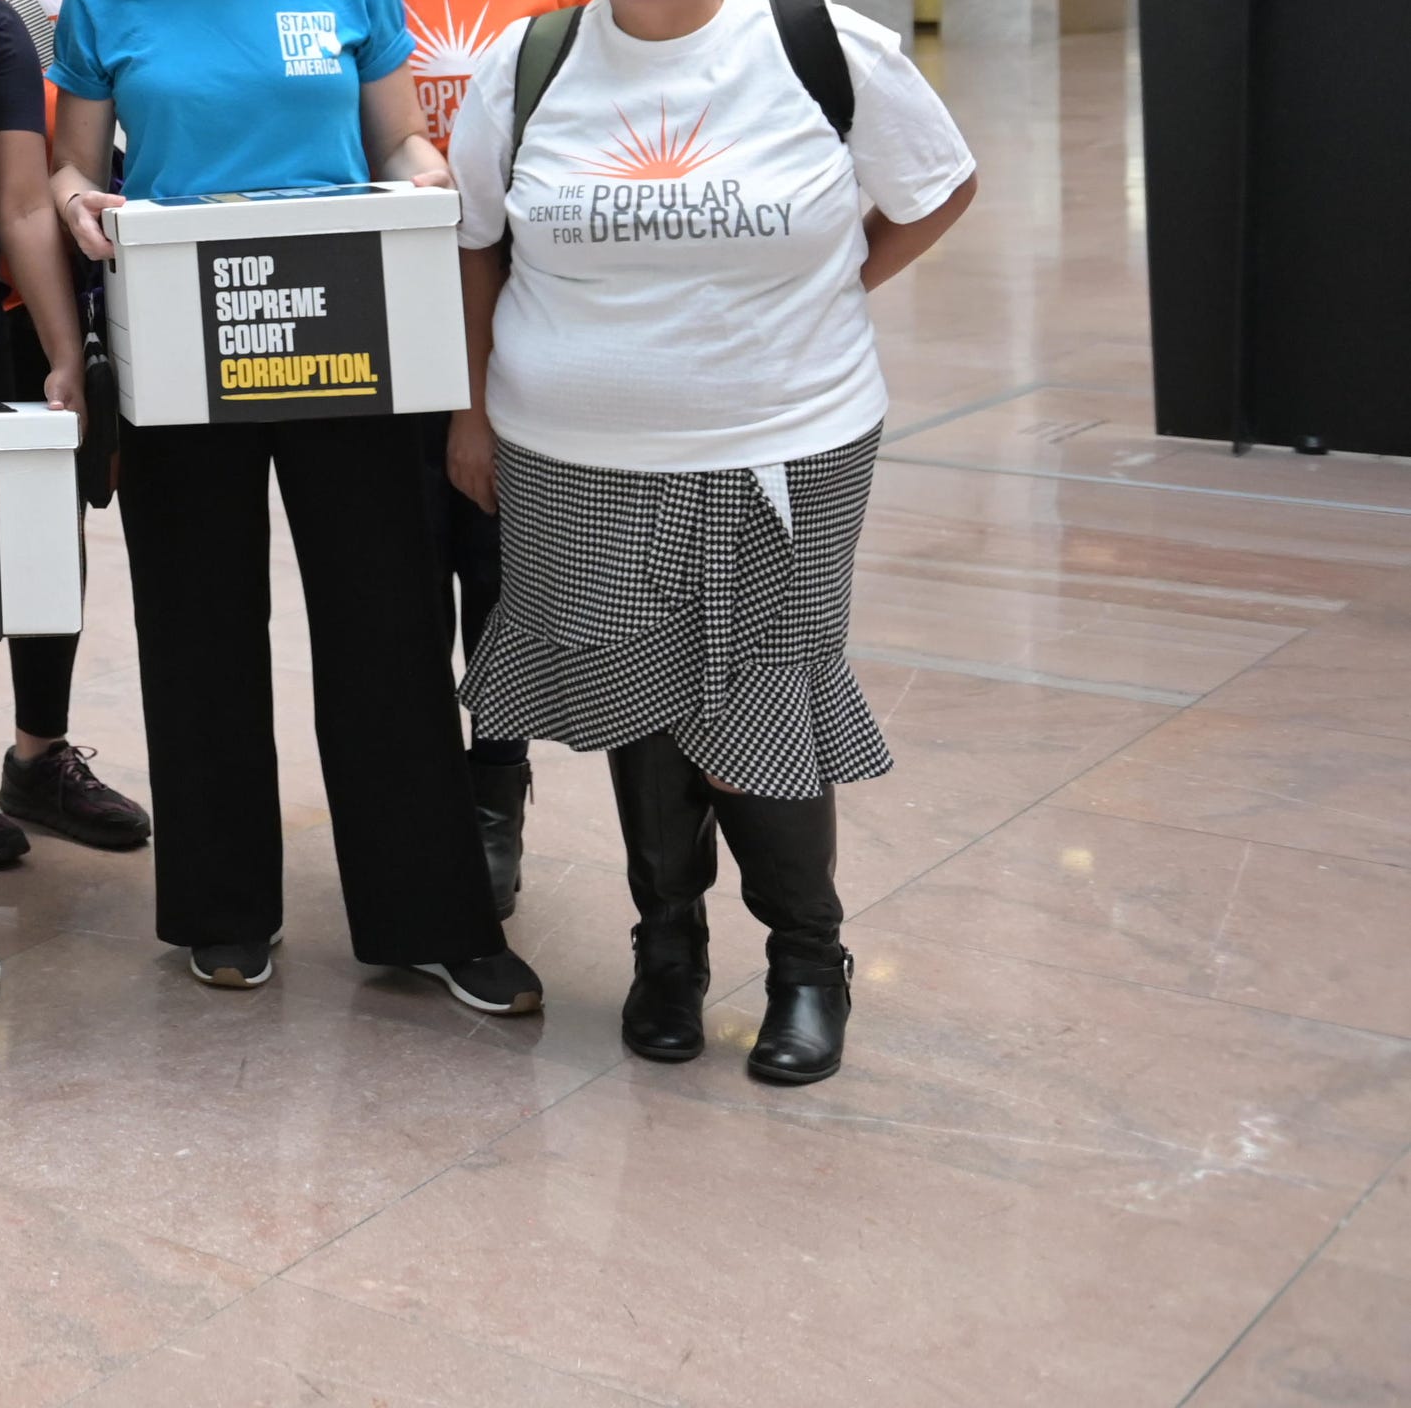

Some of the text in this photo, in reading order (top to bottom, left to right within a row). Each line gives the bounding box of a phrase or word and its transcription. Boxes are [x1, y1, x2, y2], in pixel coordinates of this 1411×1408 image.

[280, 14, 332, 33] STAND
[283, 33, 312, 57] UP
[285, 58, 343, 77] AMERICA
[558, 185, 585, 199] THE
[592, 179, 743, 213] POPULAR
[529, 205, 582, 223] CENTER
[590, 203, 792, 243] DEMOCRACY
[552, 227, 584, 244] FOR
[213, 255, 274, 288] STOP
[215, 287, 327, 322] SUPREME
[218, 322, 296, 355] COURT
[220, 352, 378, 389] CORRUPTION.
